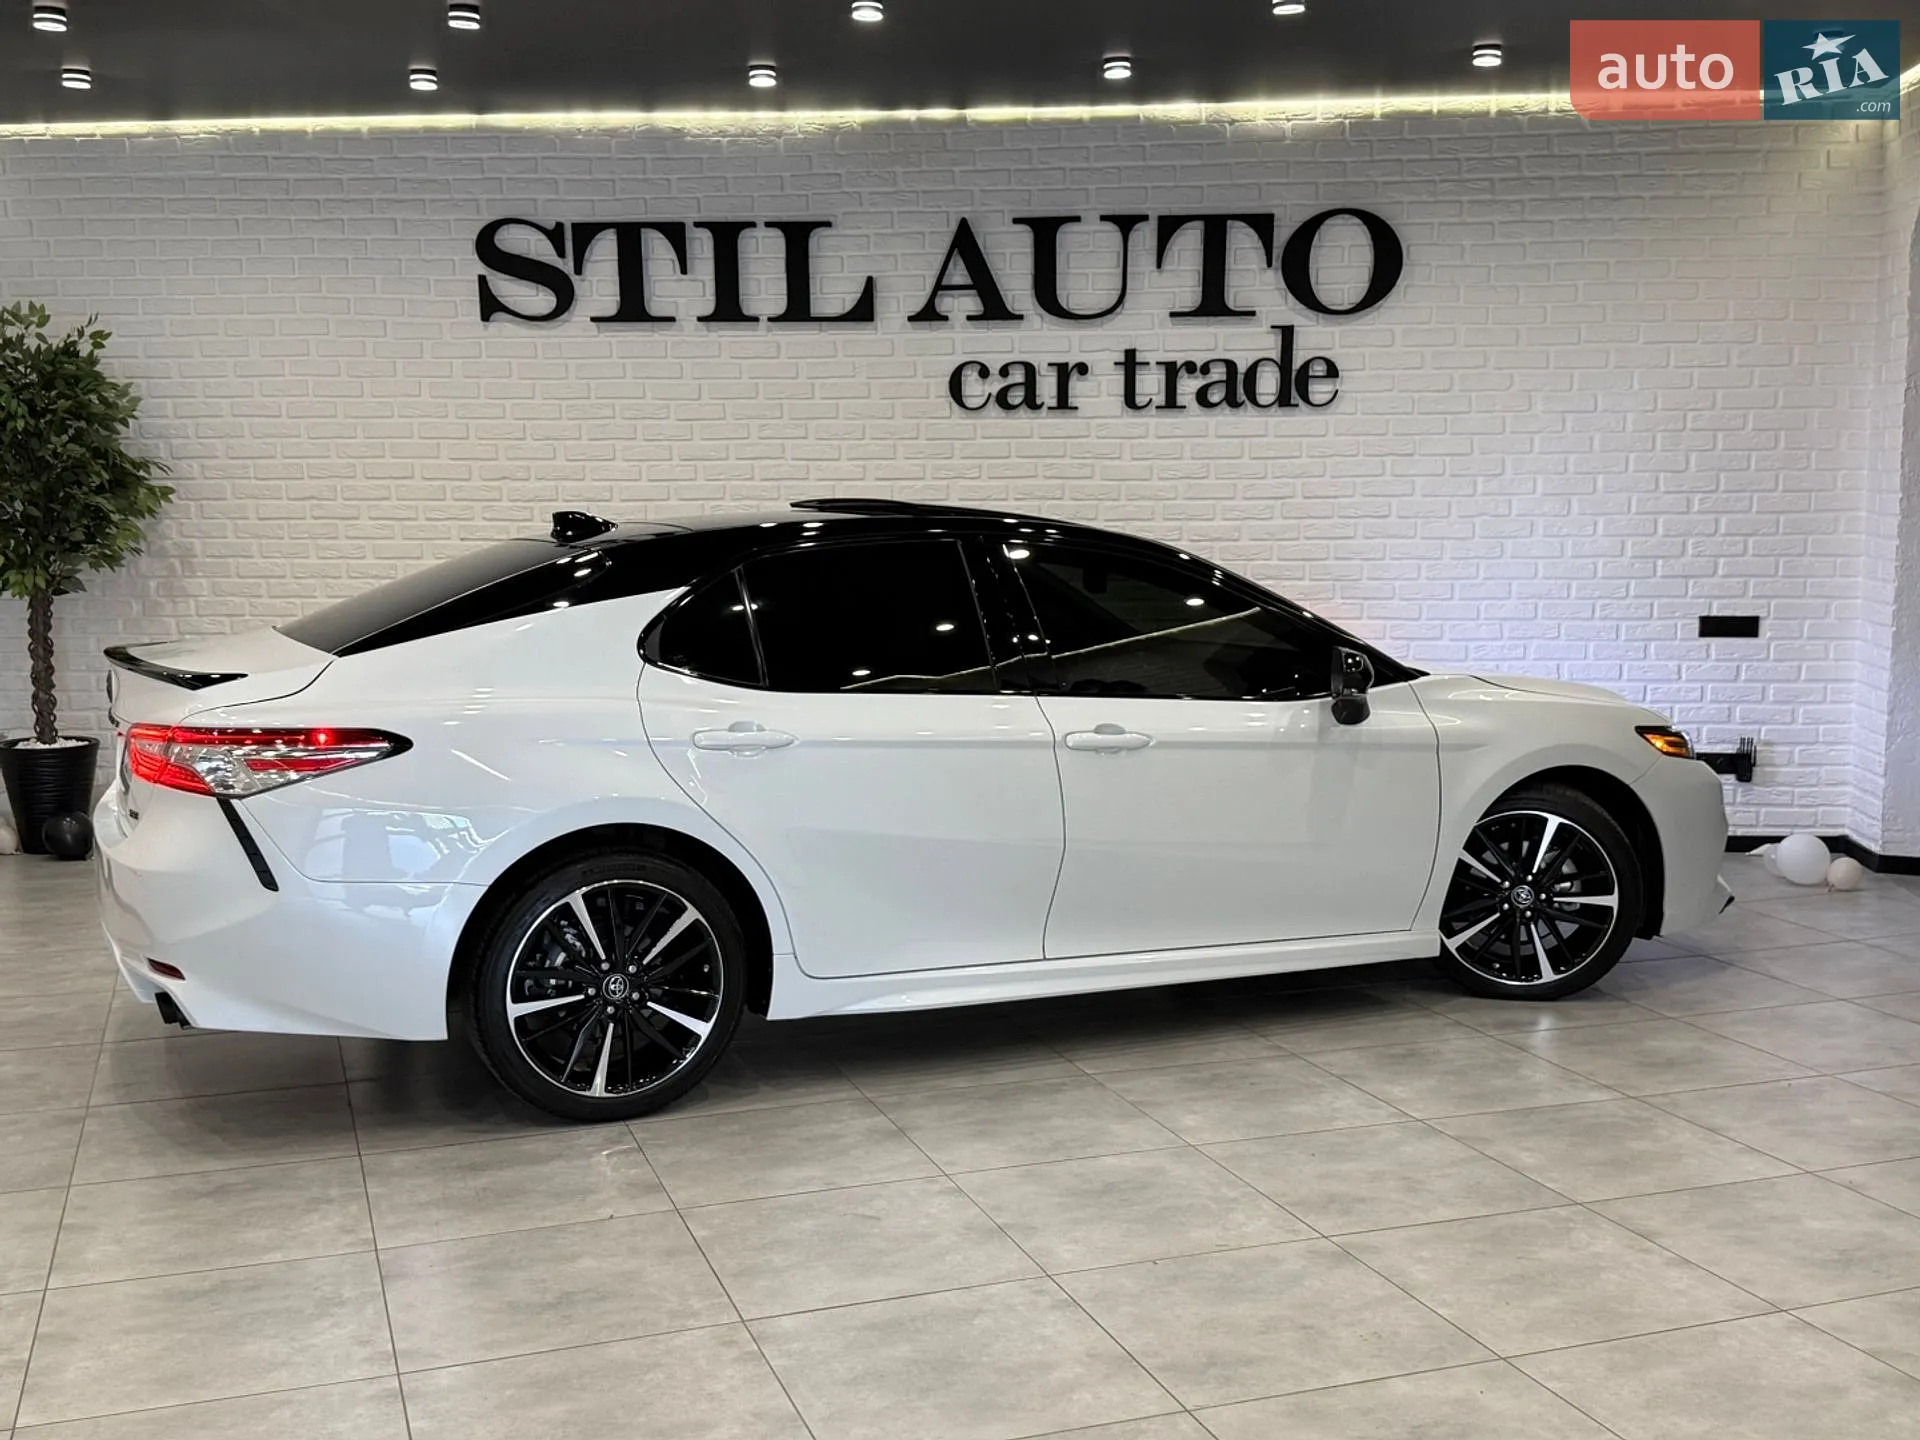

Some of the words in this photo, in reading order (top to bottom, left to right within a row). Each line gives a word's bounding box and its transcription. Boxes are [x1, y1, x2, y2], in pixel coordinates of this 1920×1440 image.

[475, 218, 875, 323] STIL
[907, 208, 1403, 322] AUTO
[949, 361, 1089, 411] car
[1114, 325, 1340, 410] trade
